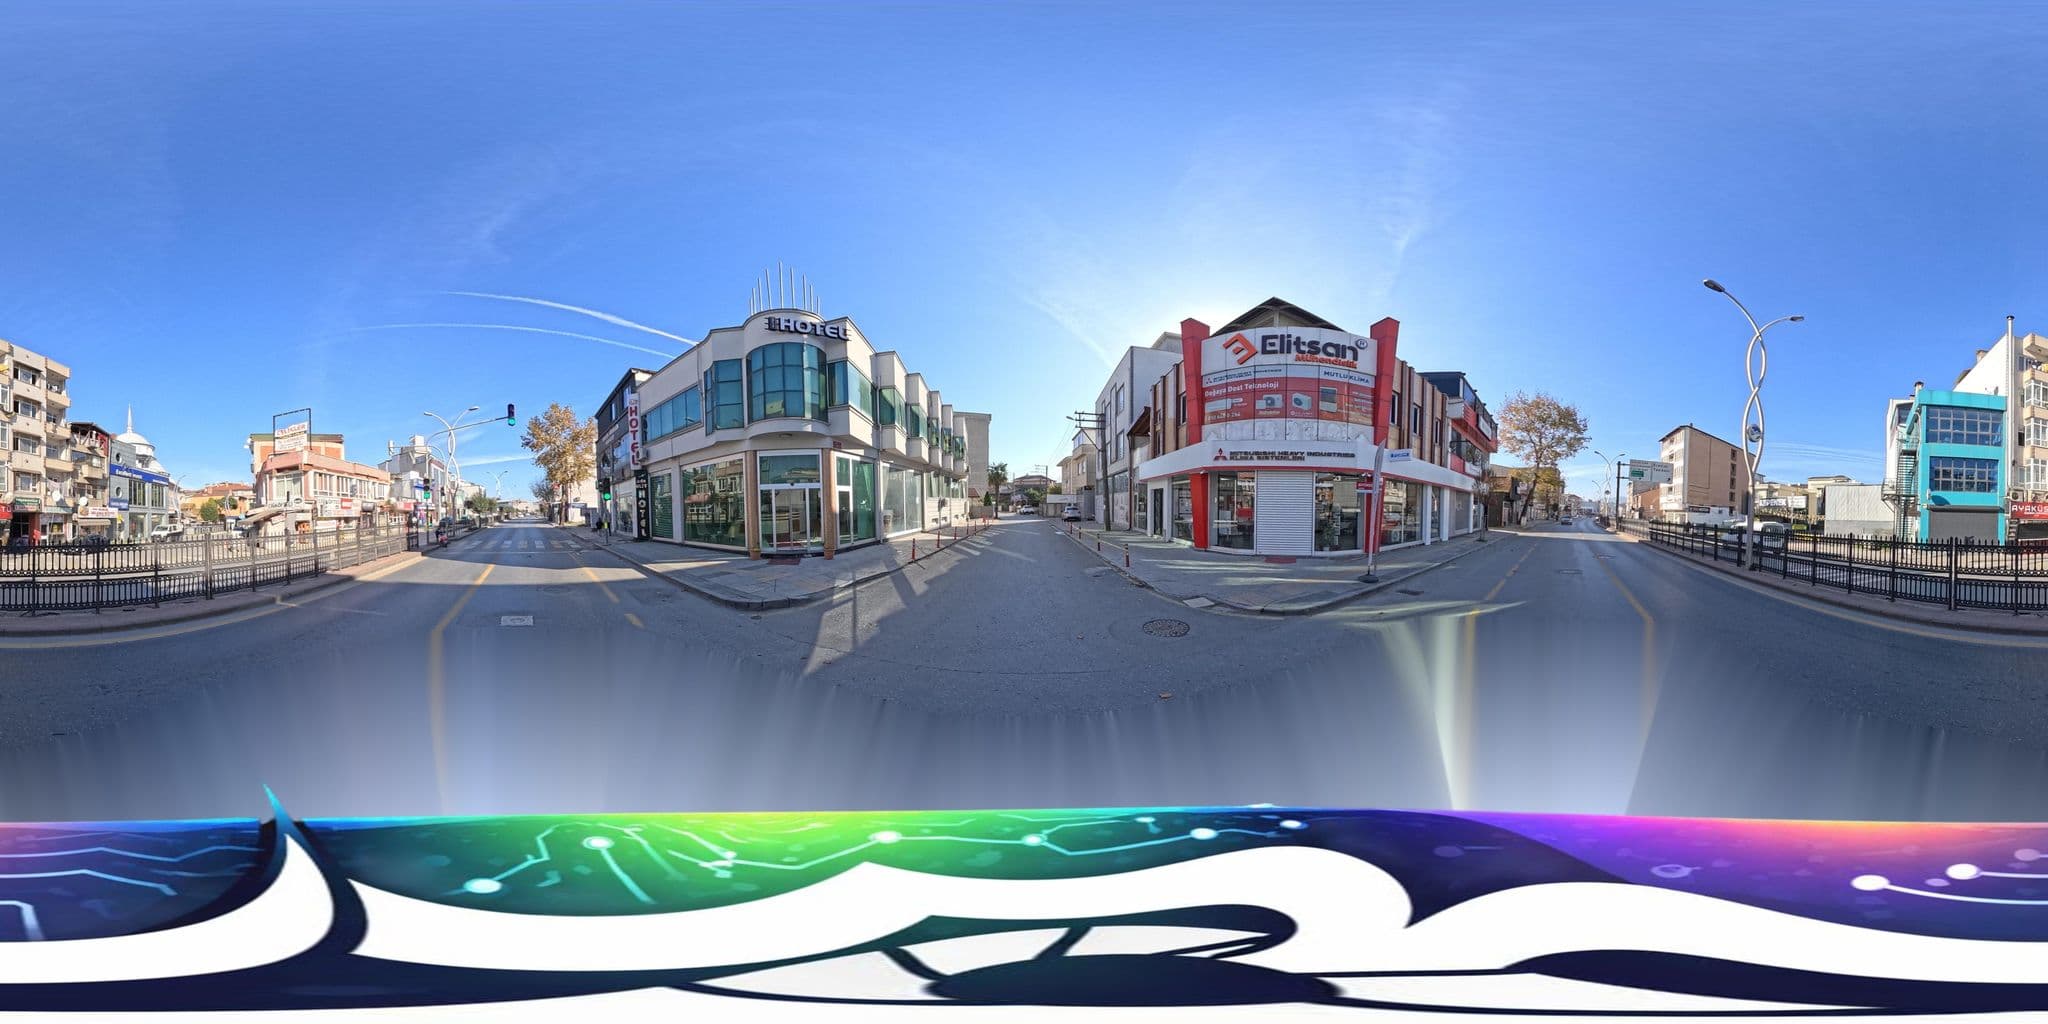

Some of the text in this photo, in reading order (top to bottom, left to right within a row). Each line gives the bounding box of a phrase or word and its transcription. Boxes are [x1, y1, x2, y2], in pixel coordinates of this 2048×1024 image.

[780, 317, 849, 340] HOTEL
[1261, 334, 1359, 361] Elitsan
[1245, 381, 1280, 391] Teknoloji
[629, 406, 640, 466] HOTEL
[638, 489, 648, 537] HOTEL
